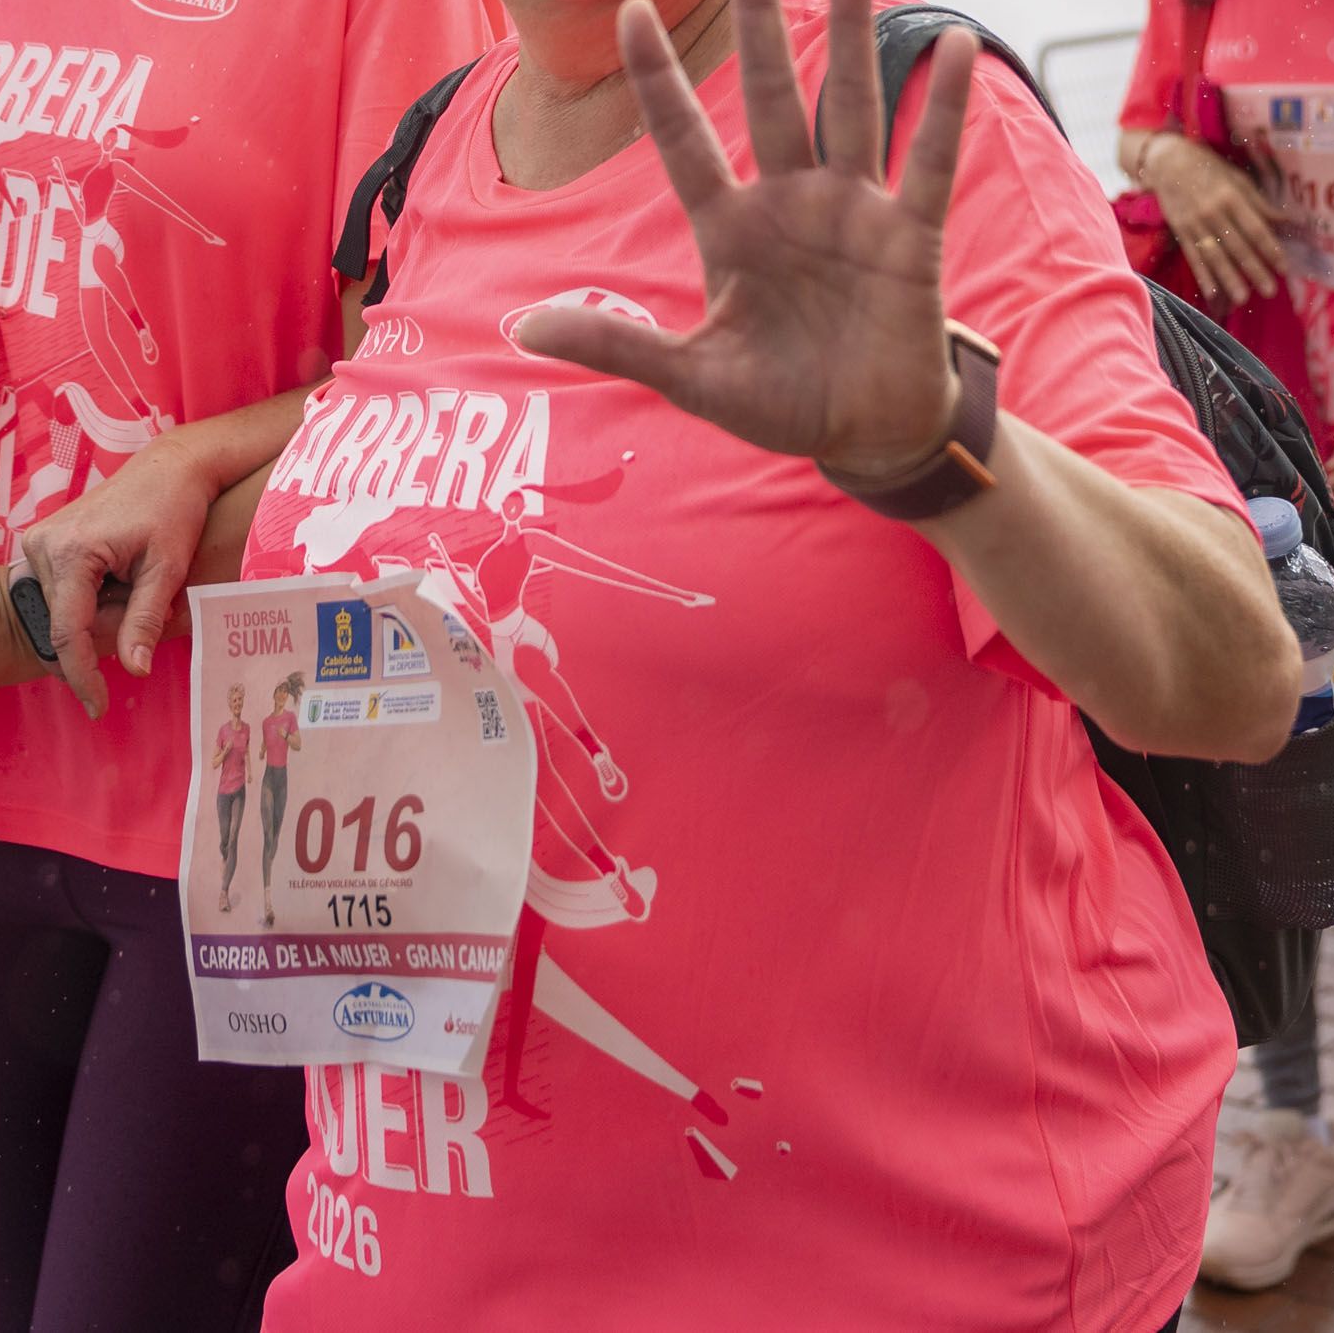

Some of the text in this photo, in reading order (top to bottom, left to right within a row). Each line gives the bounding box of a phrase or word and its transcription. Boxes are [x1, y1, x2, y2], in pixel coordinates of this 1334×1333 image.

[355, 316, 424, 360] YSHO
[223, 609, 292, 629] TU DORSAL
[227, 627, 294, 658] SUMA
[320, 665, 368, 677] Gran Canaria
[324, 654, 364, 666] Cabildo de
[295, 793, 425, 874] 016
[327, 879, 367, 888] VIOLENCIA
[327, 894, 392, 927] 1715
[199, 944, 505, 972] CARRERA DE LA MUJER GRAN CANAR
[228, 1012, 287, 1034] OYSHO
[341, 1004, 409, 1027] ASTURIANA
[307, 1171, 381, 1277] 2026
